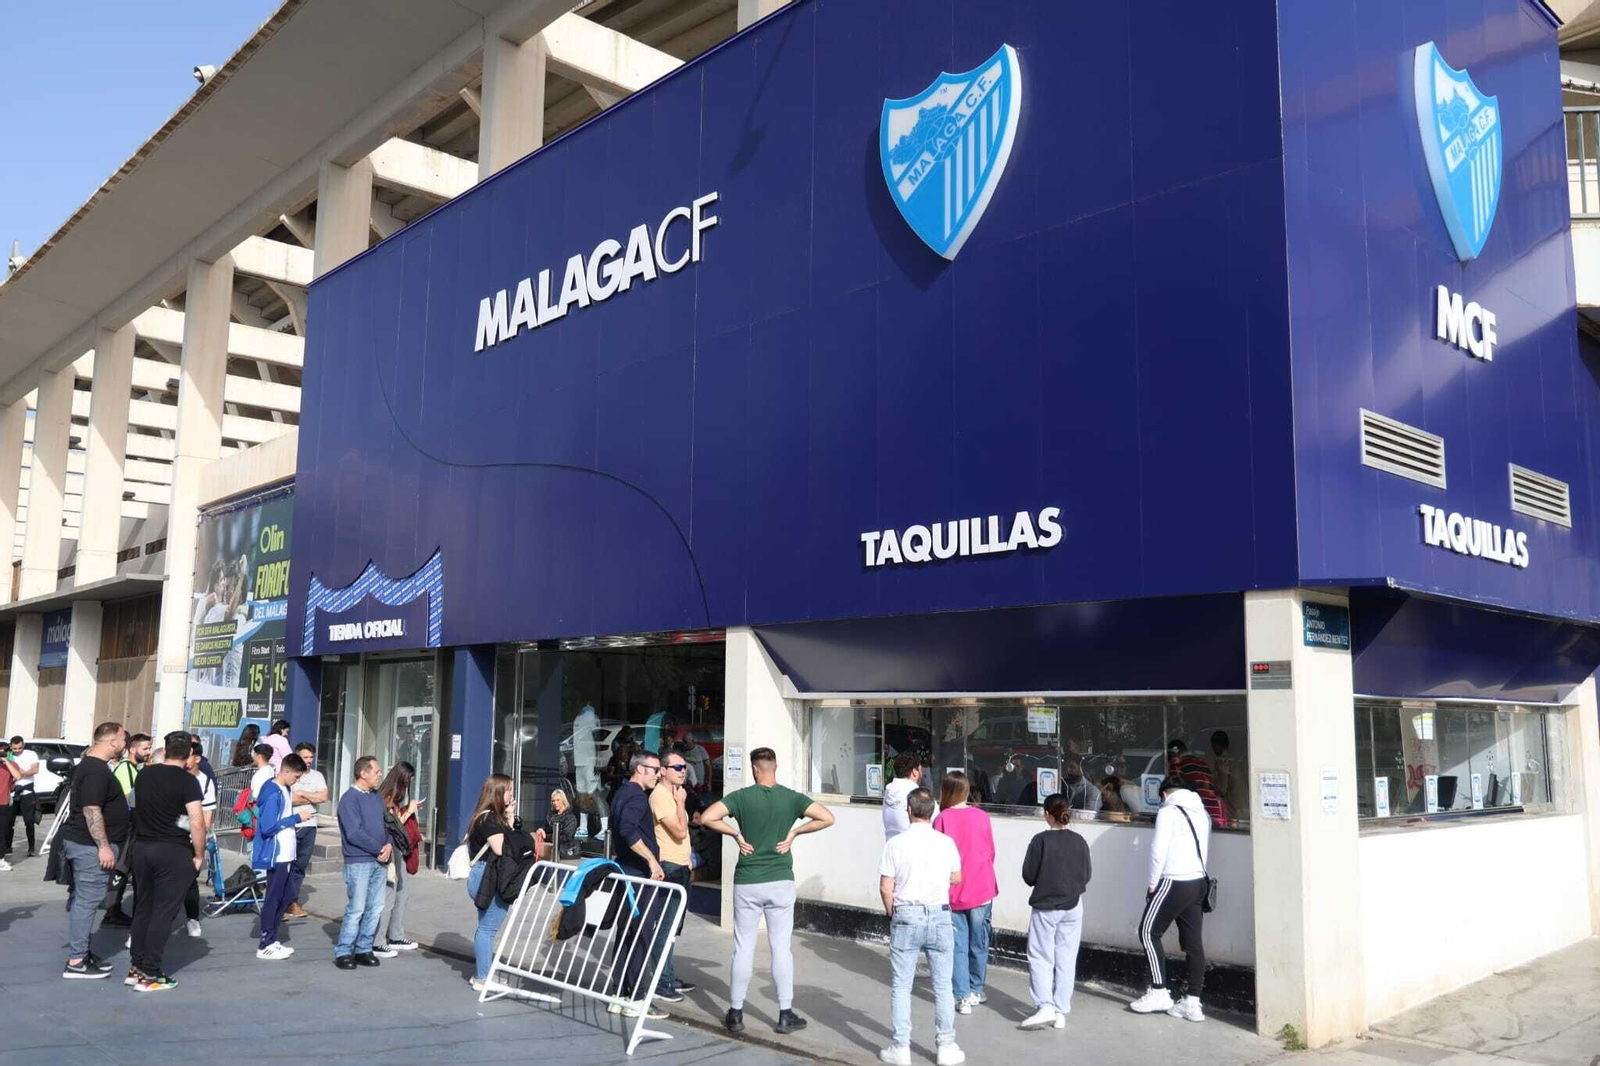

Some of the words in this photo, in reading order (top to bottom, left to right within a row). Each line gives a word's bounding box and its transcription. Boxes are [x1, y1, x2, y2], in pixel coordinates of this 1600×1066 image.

[1437, 284, 1497, 361] MCF
[260, 524, 284, 554] Olin
[861, 507, 1063, 567] TAQUILLAS
[1420, 504, 1529, 568] TAQUILLAS
[254, 606, 265, 620] DEL
[1306, 620, 1325, 630] ANTONIO
[329, 623, 363, 641] TIENDA
[363, 619, 404, 639] OFICIAL
[250, 663, 264, 693] 15
[274, 662, 287, 692] 19
[199, 701, 212, 726] POR
